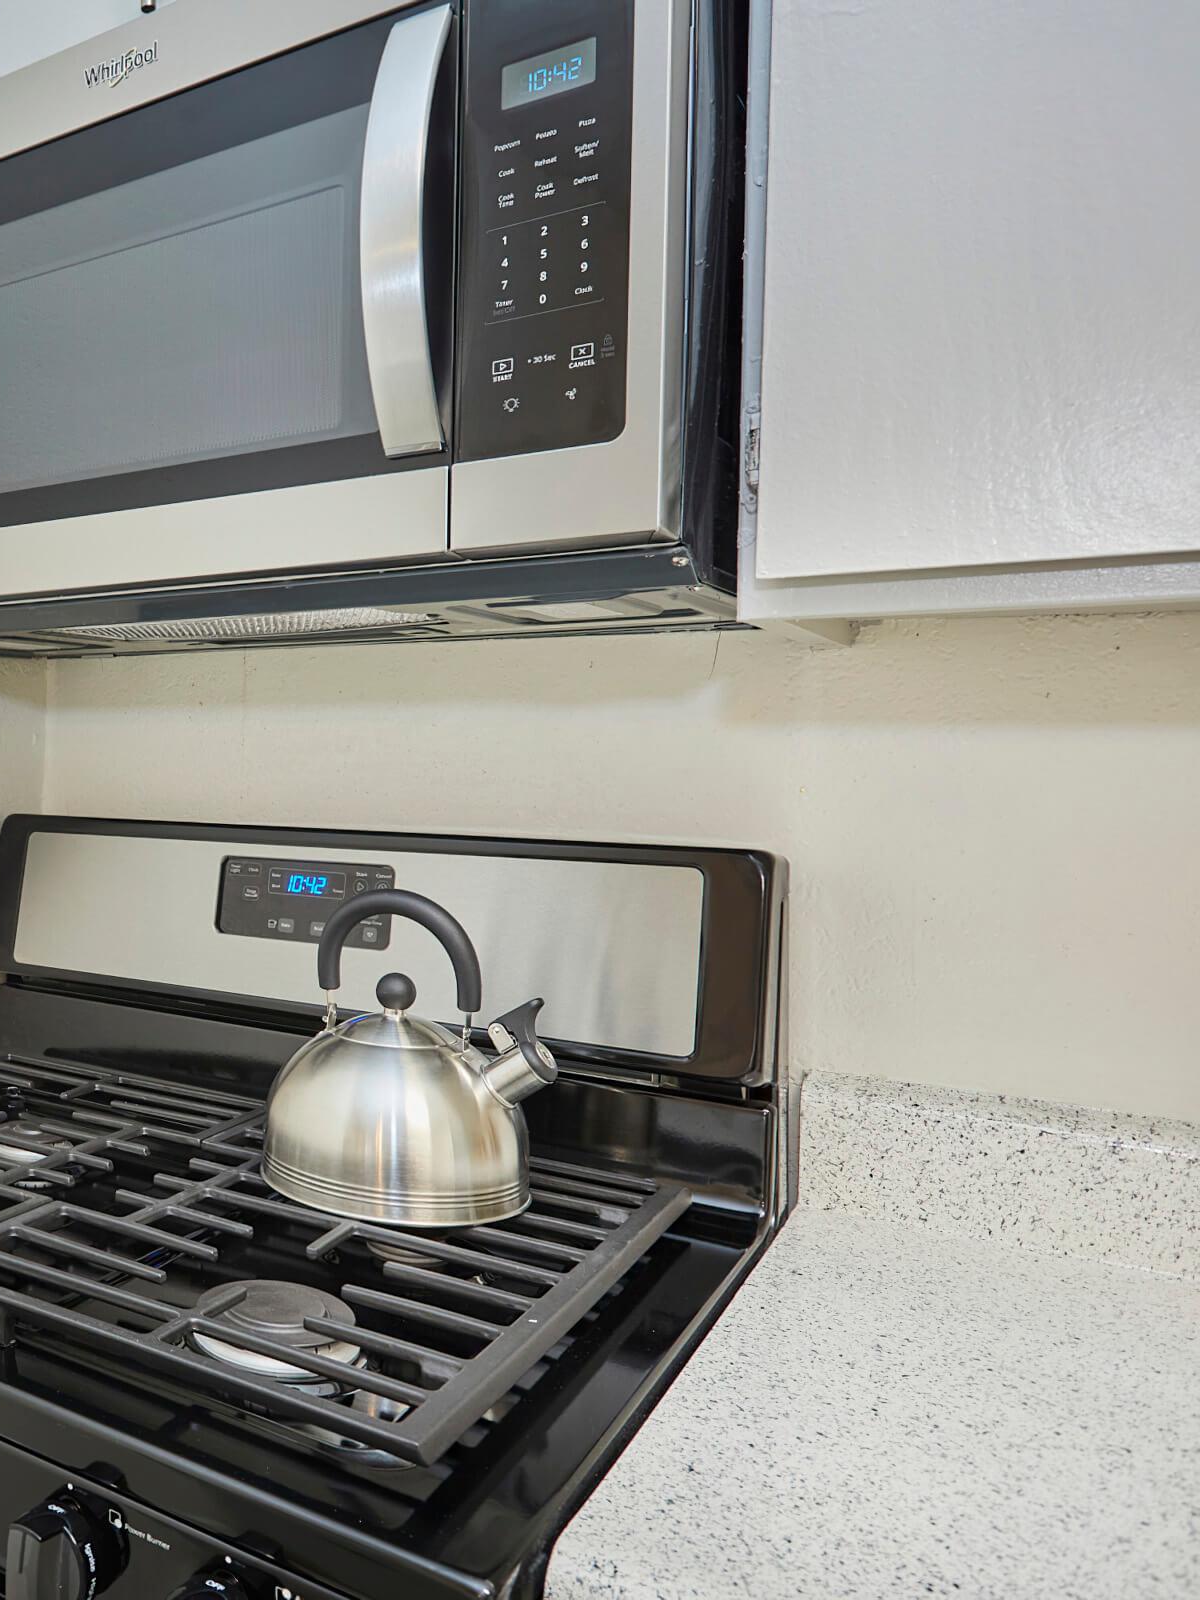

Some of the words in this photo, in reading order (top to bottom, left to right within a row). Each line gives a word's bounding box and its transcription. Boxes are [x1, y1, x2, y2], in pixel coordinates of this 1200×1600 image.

[84, 41, 157, 88] Whirlpool
[528, 56, 582, 93] 10:42
[494, 140, 521, 152] Popcorn
[498, 168, 515, 178] Cook
[536, 182, 554, 192] Cook
[581, 215, 589, 226] 3
[540, 225, 548, 236] 2
[502, 236, 508, 245] 1
[580, 238, 589, 249] 6
[540, 248, 548, 259] 5
[501, 257, 509, 267] 4
[580, 261, 588, 272] 9
[539, 271, 547, 281] 8
[501, 280, 509, 290] 7
[539, 294, 547, 304] 0
[568, 358, 596, 369] CANCEL
[287, 874, 328, 895] 10:42
